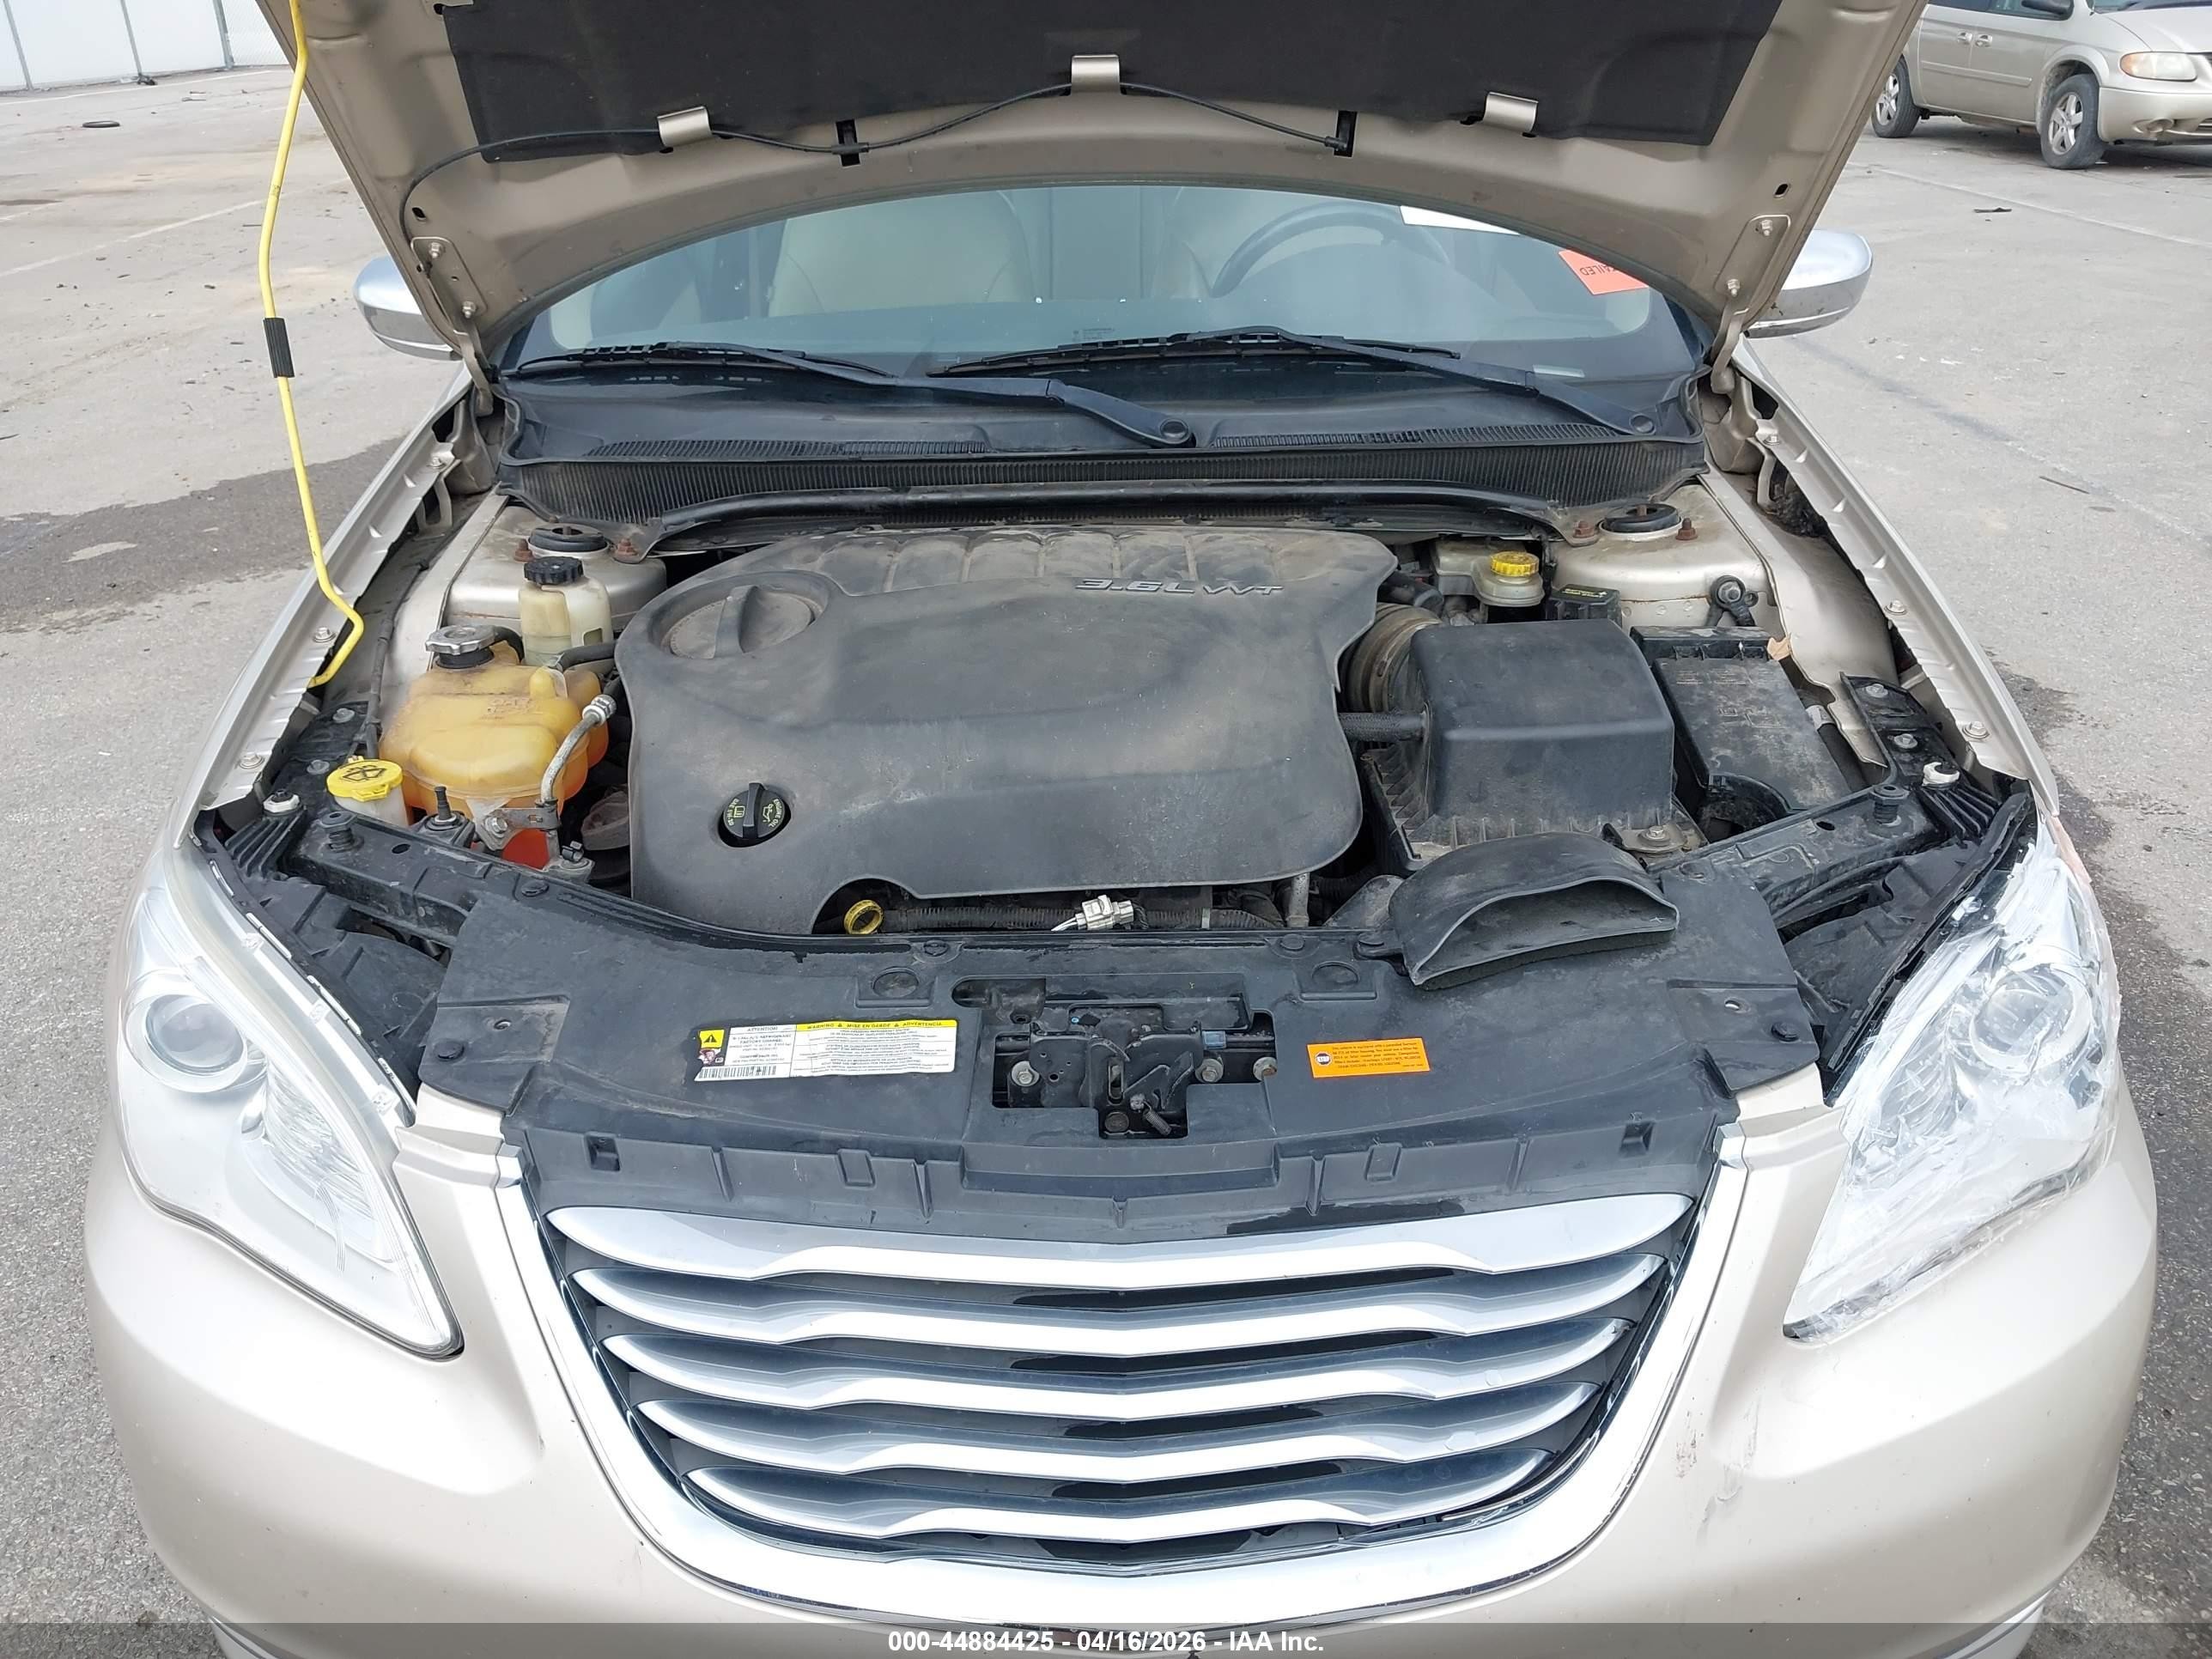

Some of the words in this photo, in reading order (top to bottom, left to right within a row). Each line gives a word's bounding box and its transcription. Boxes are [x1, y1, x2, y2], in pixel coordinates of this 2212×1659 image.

[1075, 579, 1194, 593] 3.6L
[1203, 584, 1283, 596] VVT
[774, 799, 782, 818] ENGINE
